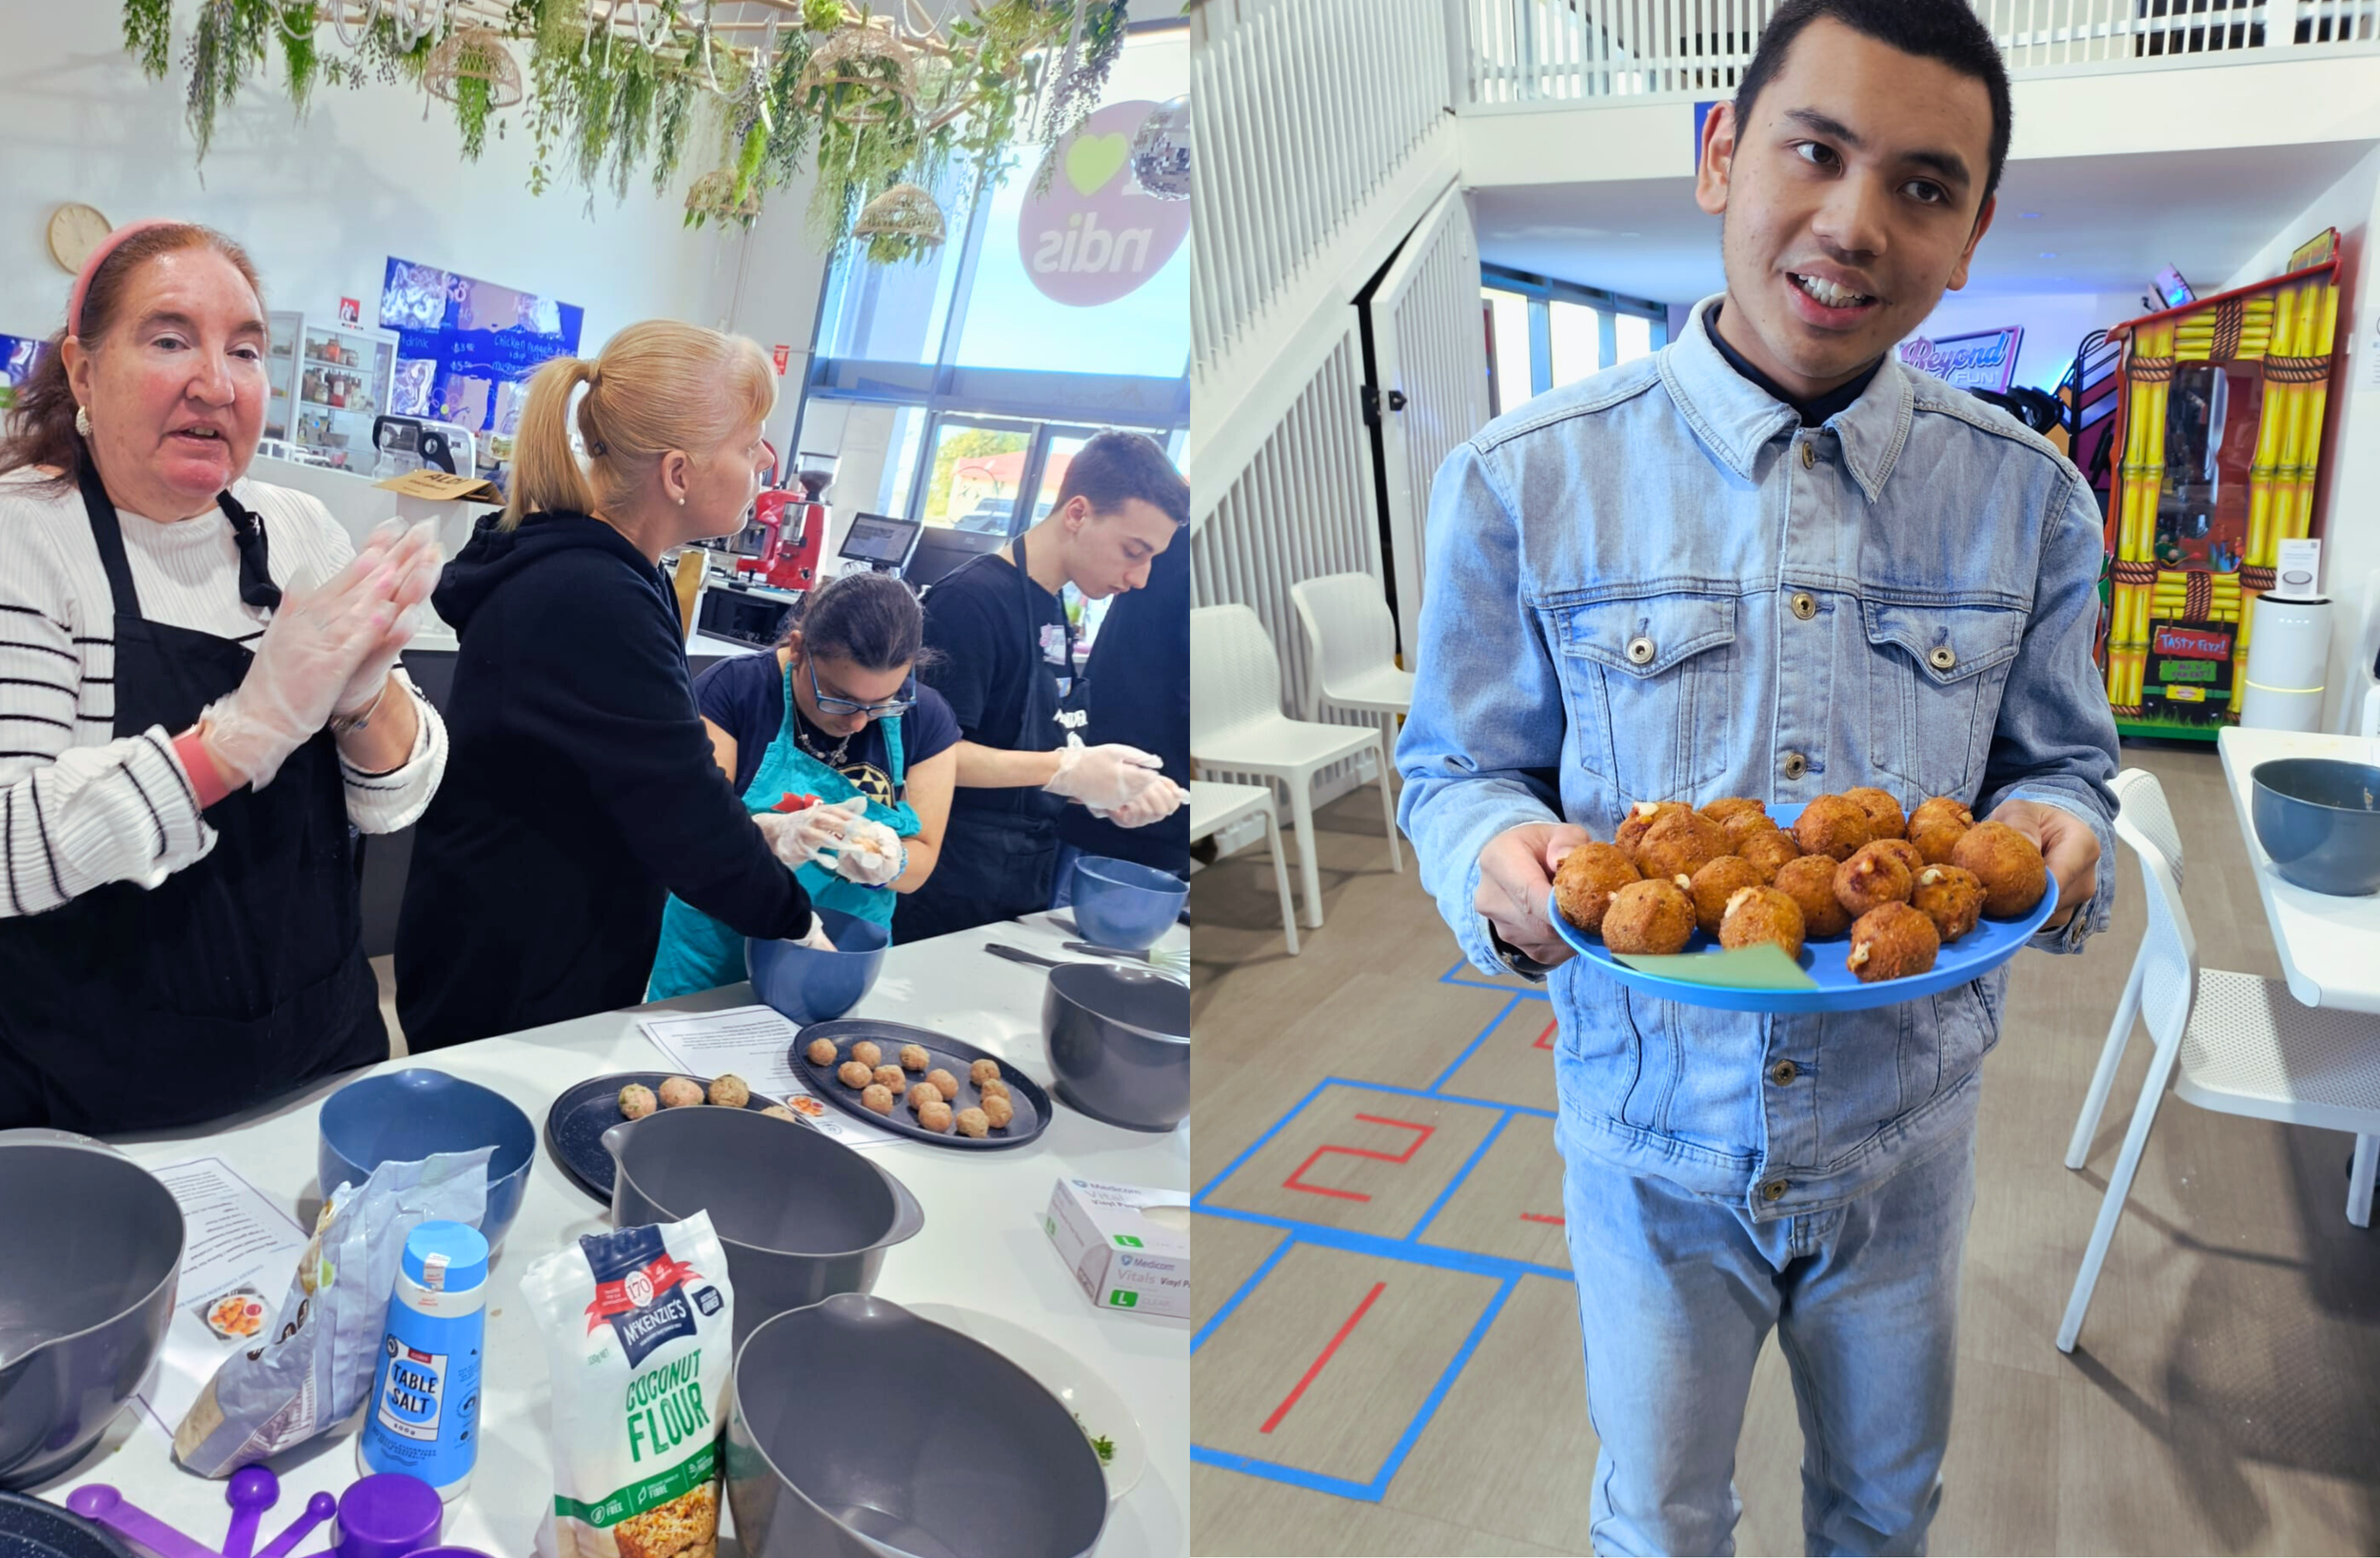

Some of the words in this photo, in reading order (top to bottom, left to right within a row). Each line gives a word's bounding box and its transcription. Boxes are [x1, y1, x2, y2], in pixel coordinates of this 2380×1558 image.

[406, 338, 429, 349] drink
[494, 335, 526, 350] Chicken
[1901, 331, 2008, 381] Beyond
[1956, 372, 1995, 384] FUN
[1281, 1113, 1436, 1202] 2
[1121, 1236, 1135, 1246] L
[1134, 1257, 1176, 1272] Medicom
[1118, 1269, 1156, 1284] Vitals
[627, 1278, 651, 1300] 170
[1118, 1292, 1128, 1305] L
[392, 1364, 437, 1394] TABLE
[625, 1349, 702, 1412] COCONUT
[391, 1388, 429, 1414] SALT
[627, 1382, 710, 1463] FLOUR
[606, 1503, 624, 1517] FREE
